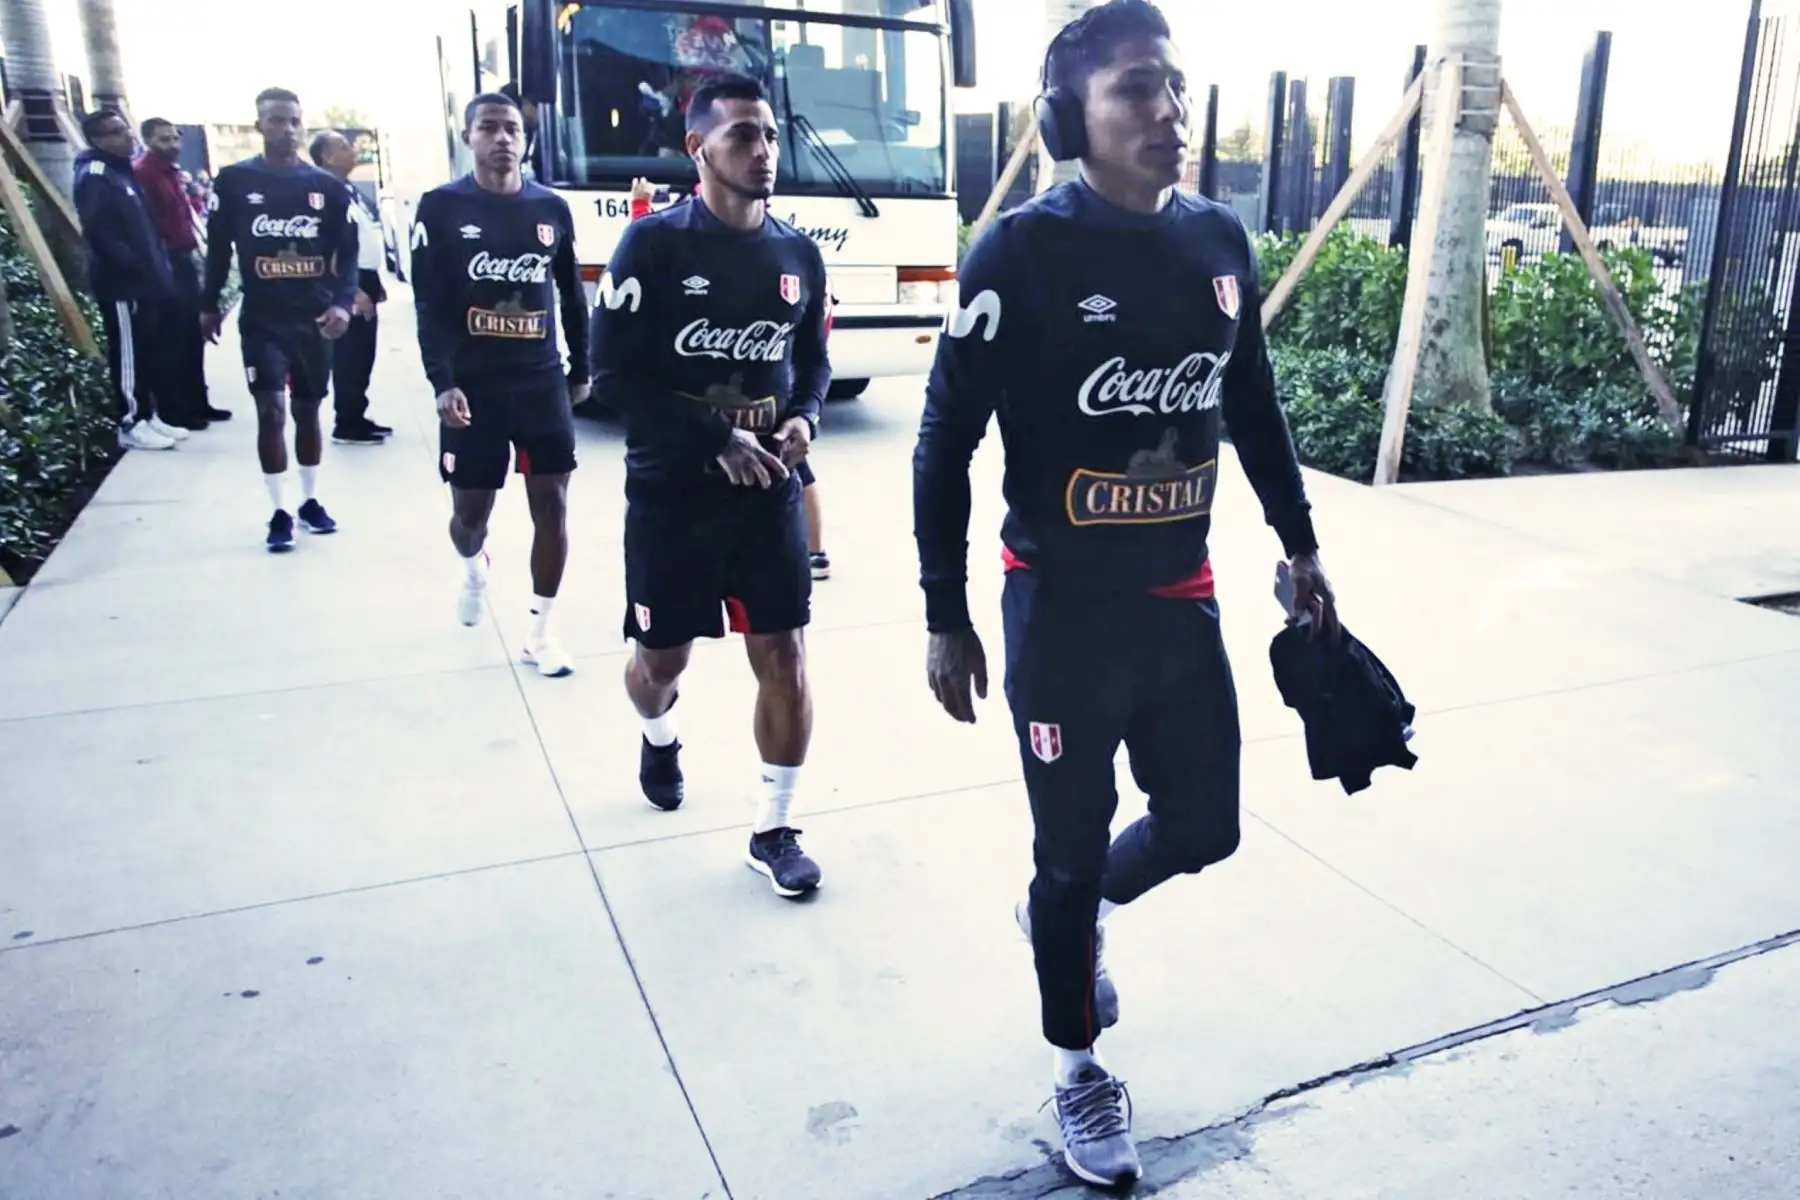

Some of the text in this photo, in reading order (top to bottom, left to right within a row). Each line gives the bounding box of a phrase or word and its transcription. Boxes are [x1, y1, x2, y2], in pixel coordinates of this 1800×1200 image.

[594, 198, 630, 218] 164
[475, 313, 541, 333] CRISTAL
[1086, 476, 1208, 514] CRISTAL
